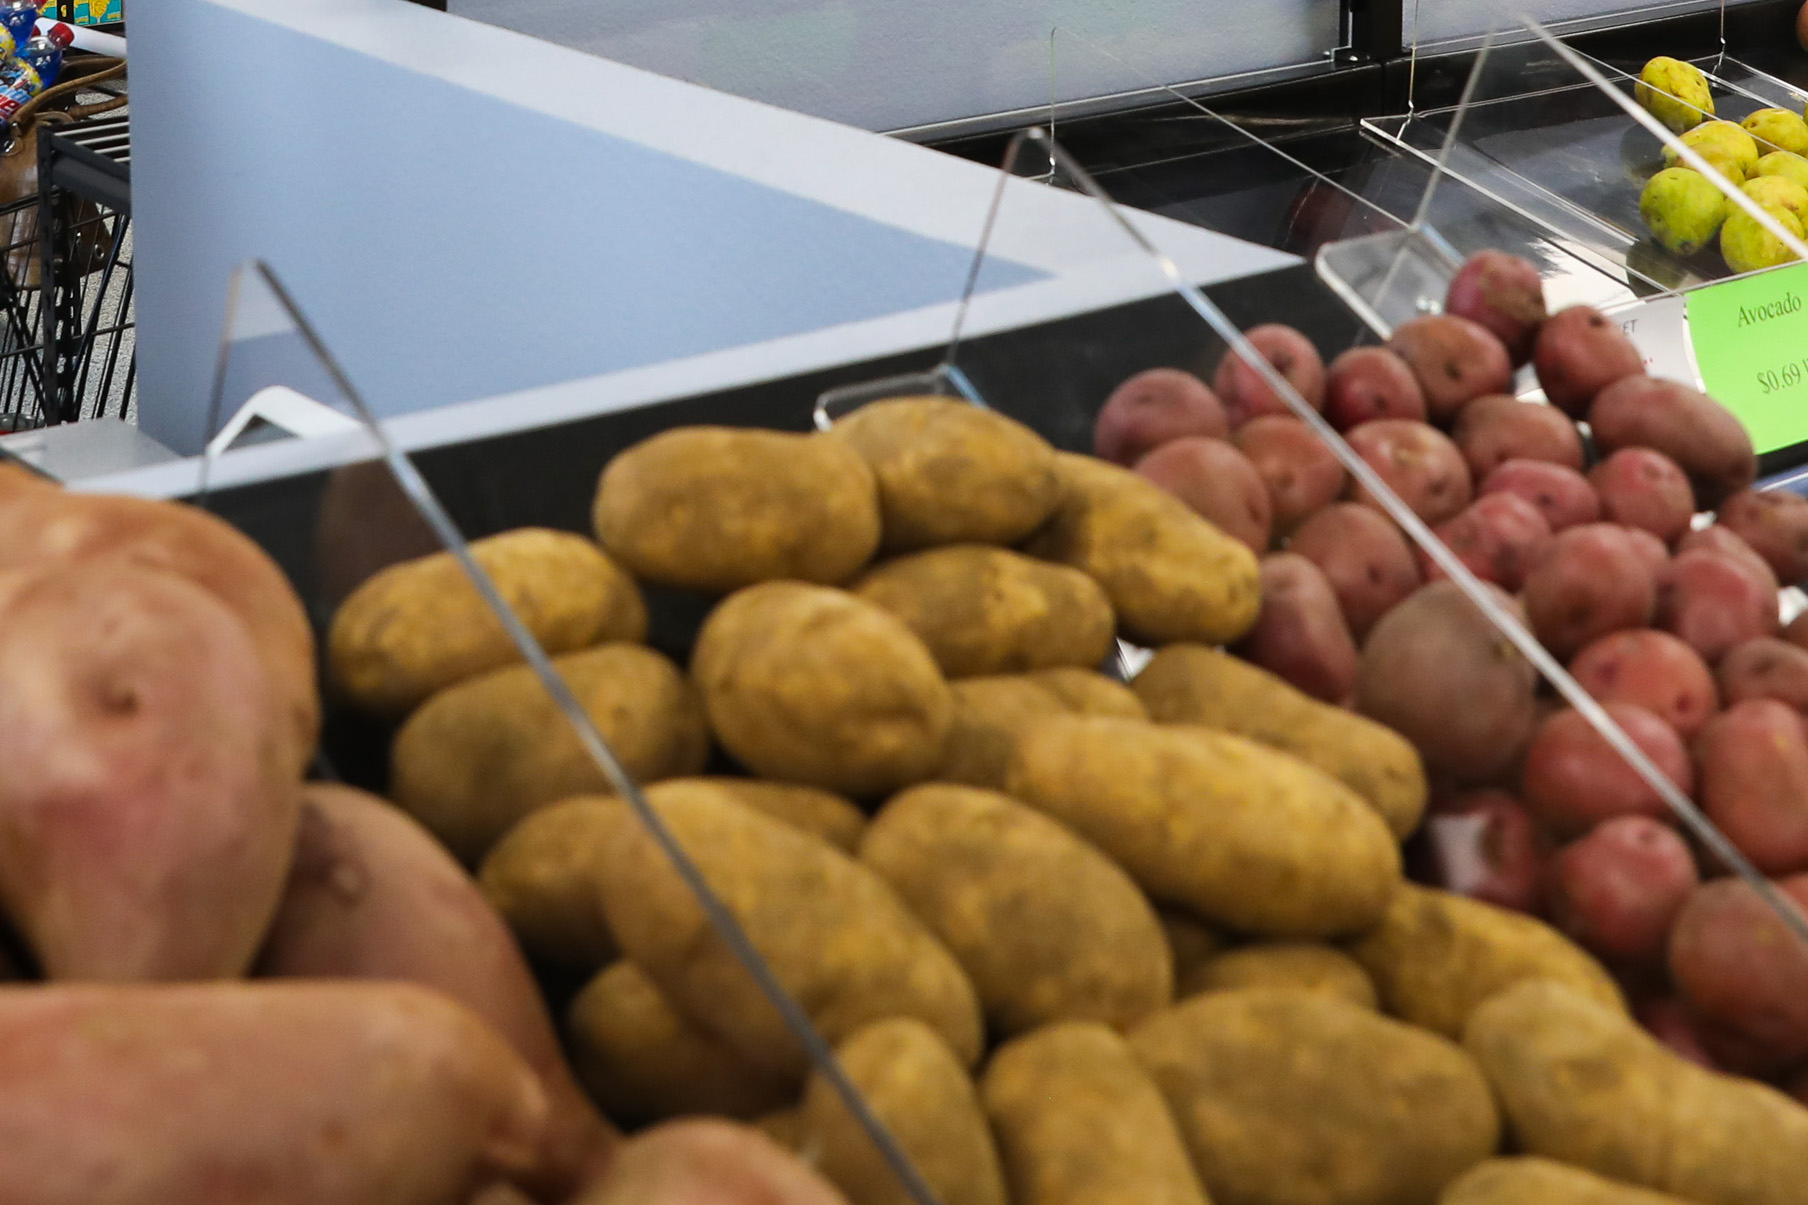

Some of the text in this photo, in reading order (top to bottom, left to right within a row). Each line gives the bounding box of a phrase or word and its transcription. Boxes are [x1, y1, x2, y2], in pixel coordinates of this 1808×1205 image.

[1737, 292, 1802, 328] Avocado
[1622, 319, 1638, 335] ET
[1757, 363, 1802, 395] $0.69
